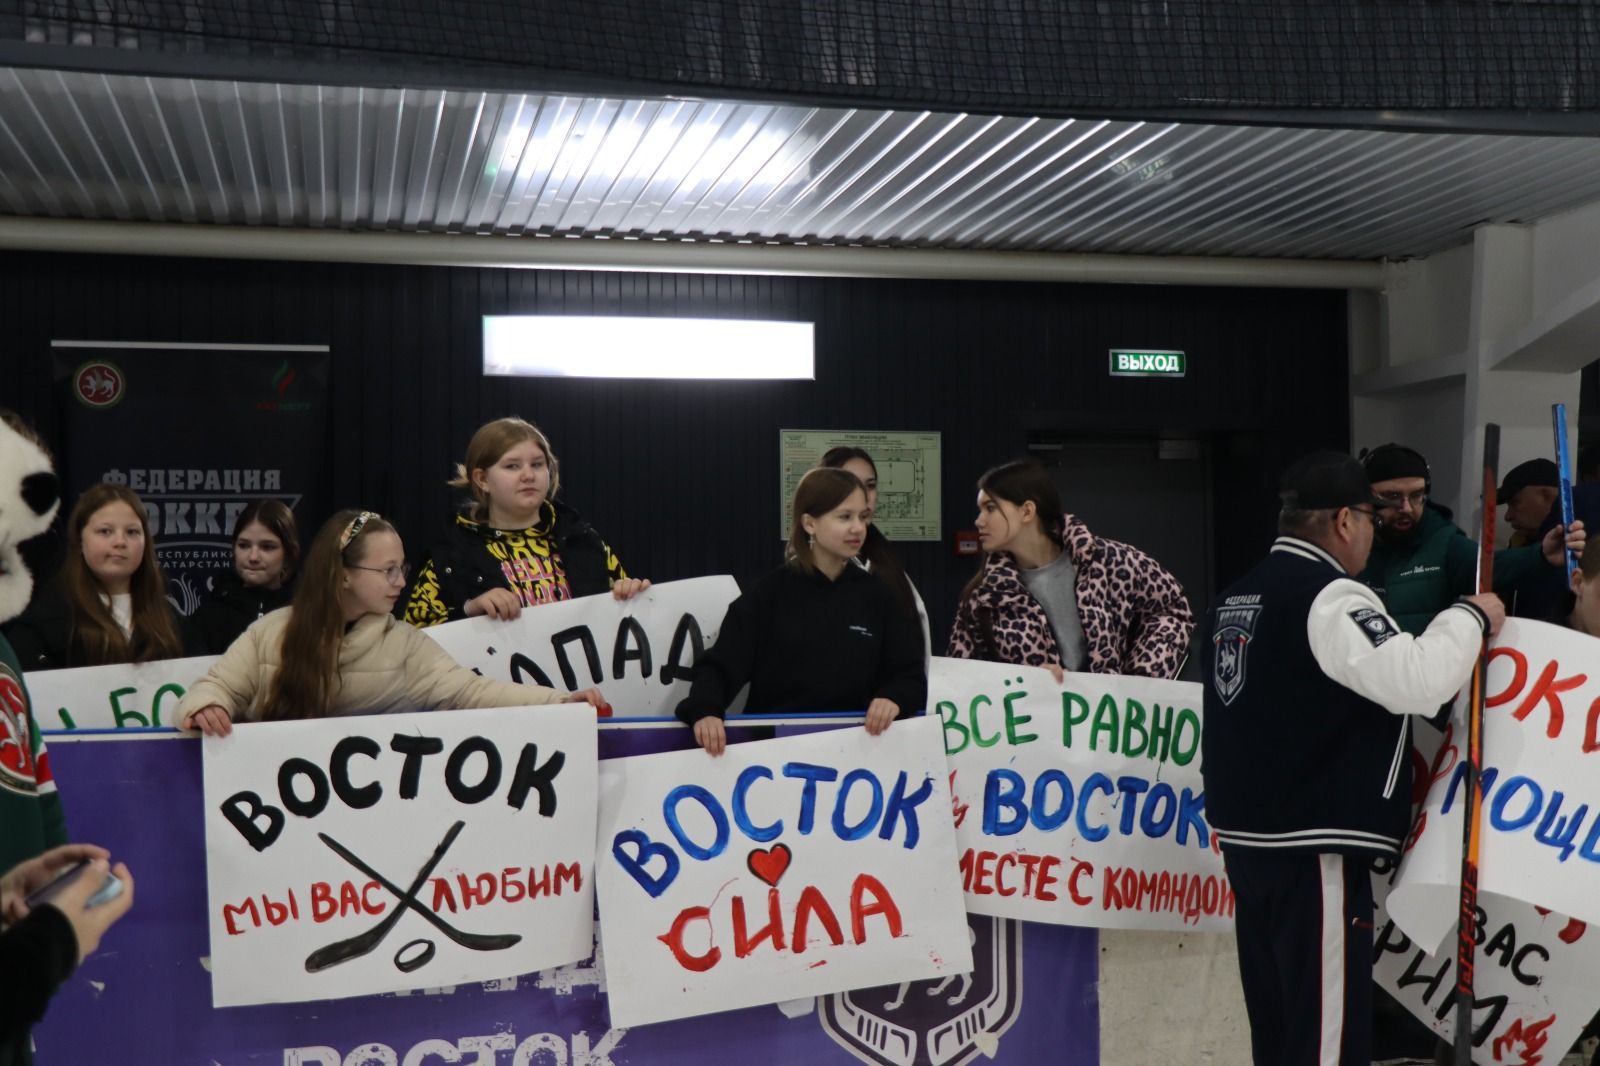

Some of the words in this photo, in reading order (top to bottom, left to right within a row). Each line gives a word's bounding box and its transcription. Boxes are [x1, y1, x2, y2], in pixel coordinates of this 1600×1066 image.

[1118, 354, 1180, 372] ВЫХОД
[103, 469, 281, 493] ФЕДЕРАЦИЯ
[144, 502, 248, 536] ОККЕ
[157, 551, 233, 559] ЕСПУБЛИК
[936, 676, 1038, 755] ВСЁ
[1062, 691, 1200, 766] РАВНО
[220, 733, 566, 852] ВОСТОК
[982, 768, 1210, 849] ВОСТОК
[611, 762, 935, 898] ВОСТОК
[223, 888, 299, 935] МЫ
[311, 881, 386, 923] ВАС
[427, 861, 583, 914] ЛЮБИМ
[1067, 856, 1094, 906] С
[657, 873, 903, 972] СИЛА
